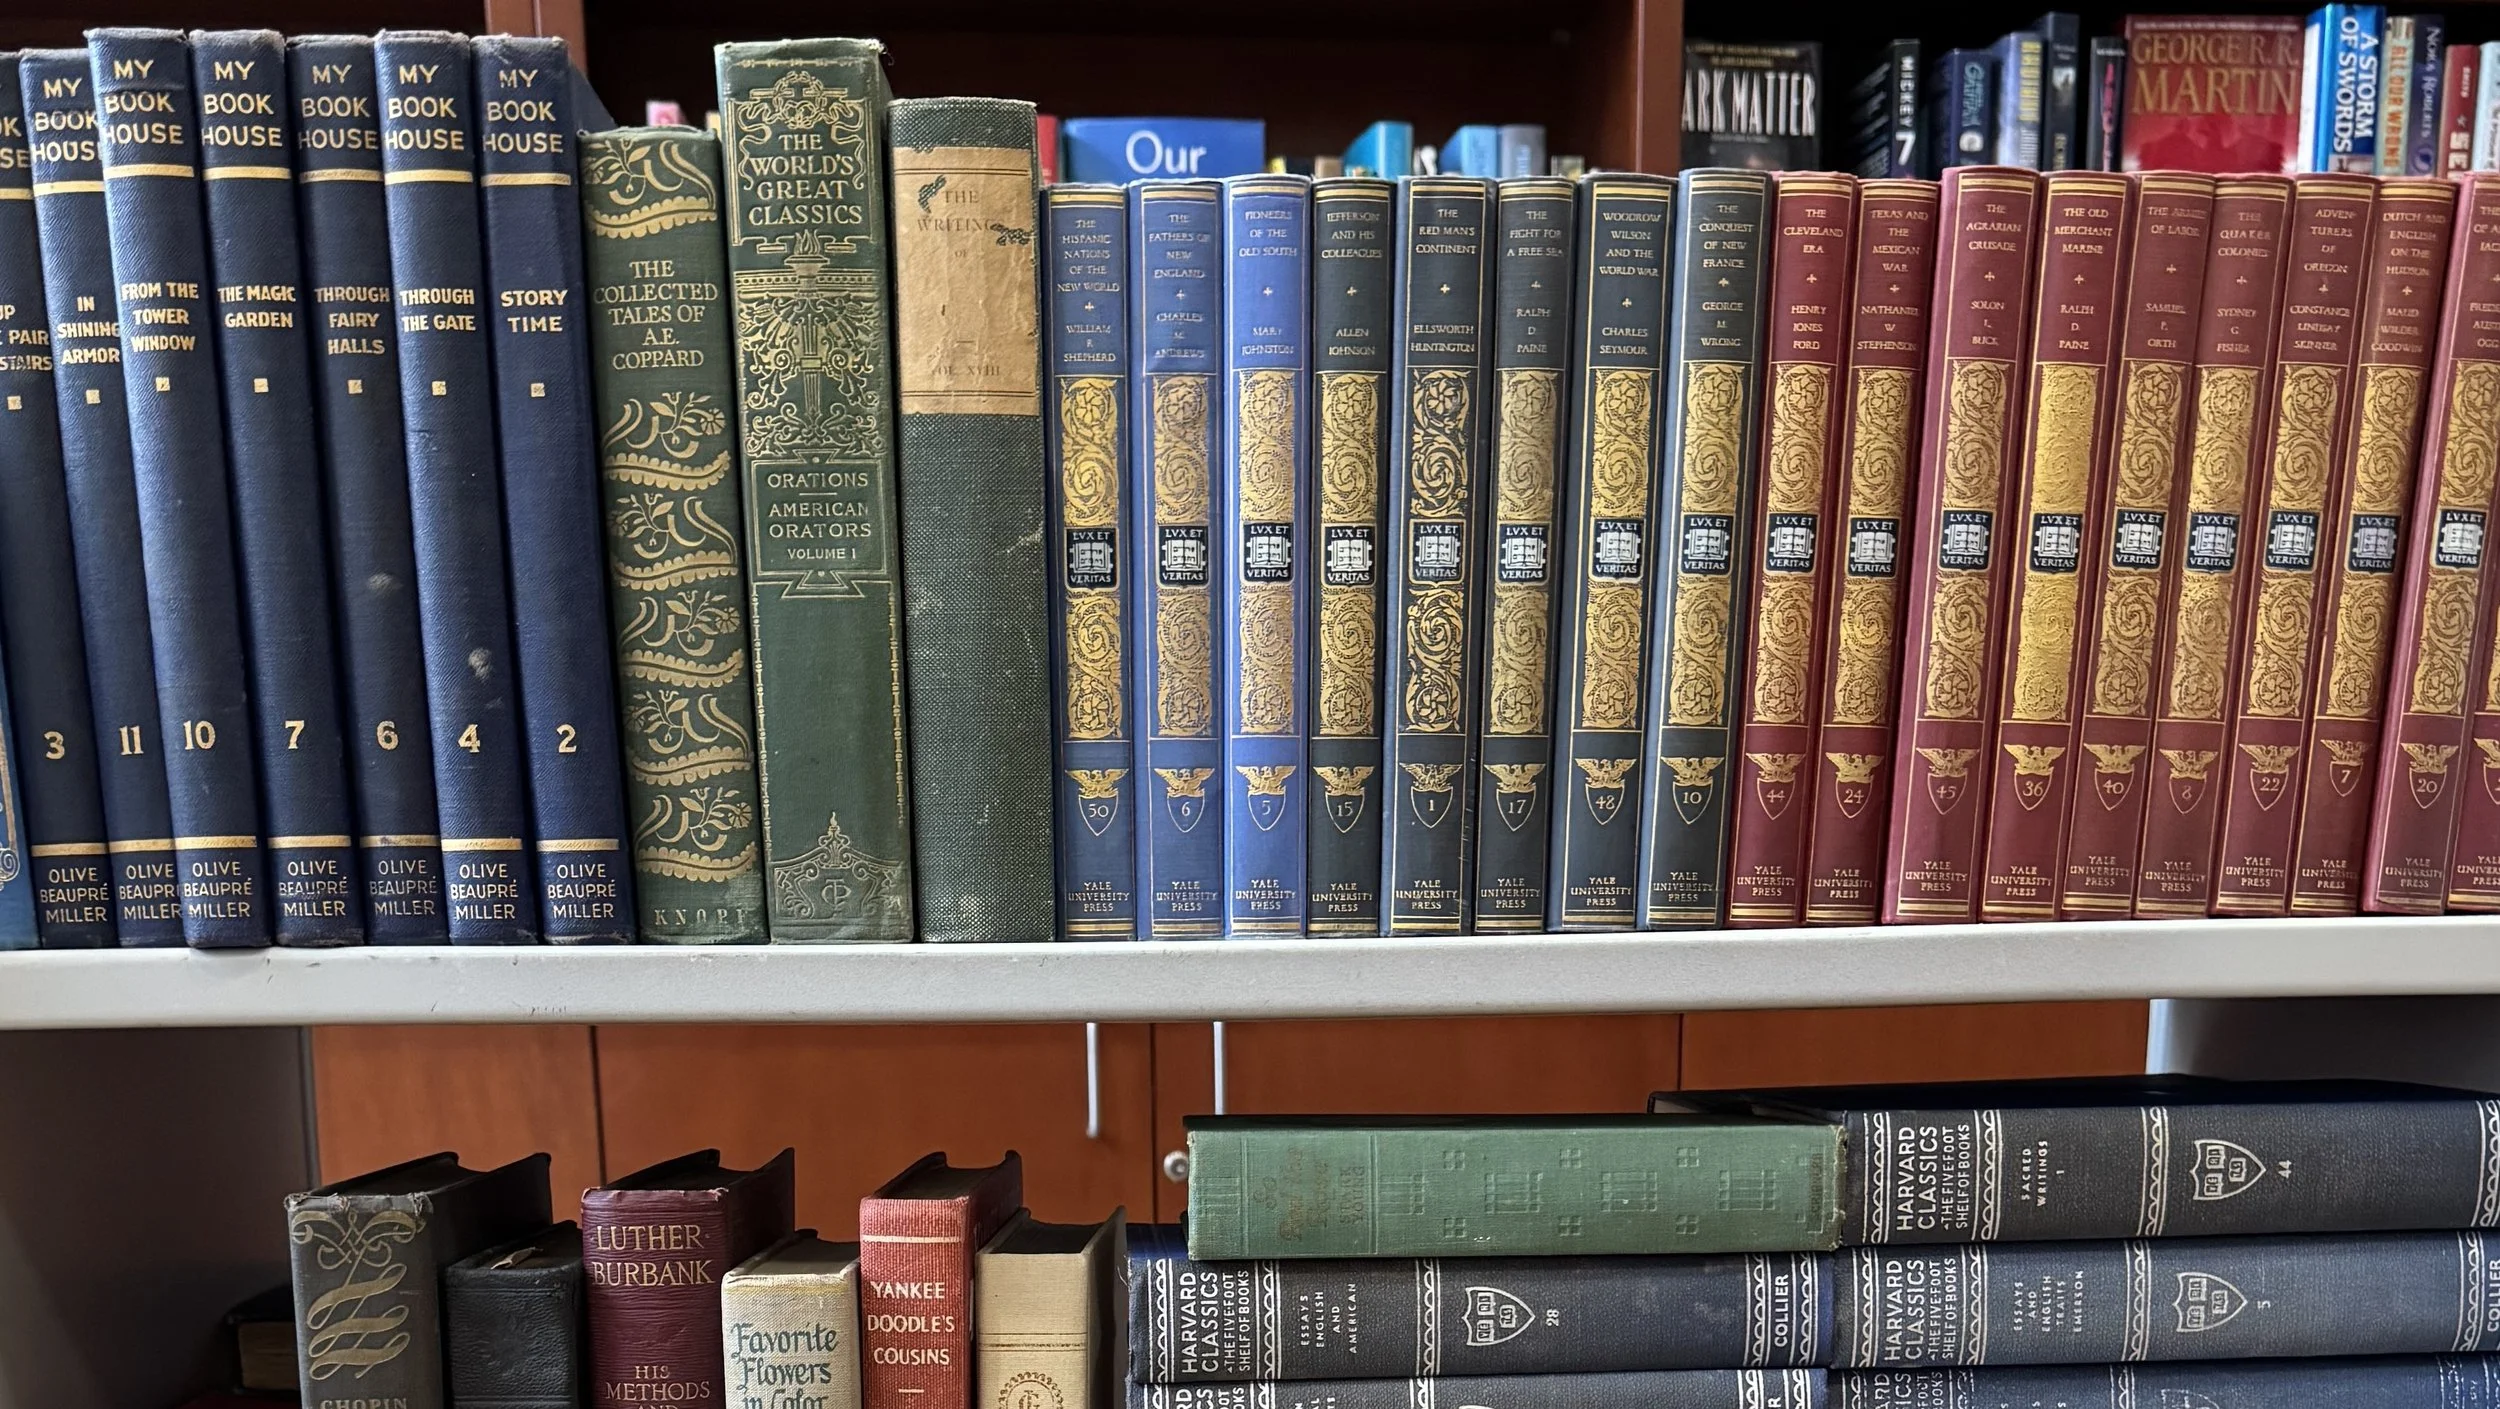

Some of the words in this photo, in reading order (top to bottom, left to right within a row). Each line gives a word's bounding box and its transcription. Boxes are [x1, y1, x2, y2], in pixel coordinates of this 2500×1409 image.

[2340, 18, 2359, 48] OF
[2357, 32, 2378, 51] A
[2134, 34, 2244, 64] GEORGE
[2247, 35, 2276, 67] R.
[2277, 38, 2299, 67] R.
[114, 60, 153, 80] MY
[313, 65, 351, 84] MY
[500, 69, 537, 88] MY
[1900, 57, 1914, 126] MICKEY
[2135, 68, 2296, 117] MARTIN
[2353, 54, 2380, 139] STORM
[103, 92, 173, 114] BOOK
[302, 97, 369, 116] BOOK
[487, 100, 555, 121] BOOK
[1732, 72, 1814, 135] MATTER
[2334, 52, 2357, 151] SWORDS
[103, 123, 182, 145] HOUSE
[304, 129, 375, 148] HOUSE
[484, 132, 562, 153] HOUSE
[779, 135, 822, 150] THE
[1126, 131, 1205, 173] Our
[1896, 132, 1915, 164] 7
[748, 153, 855, 176] WORLD'S
[757, 181, 848, 200] GREAT
[942, 191, 979, 204] THE
[749, 205, 862, 225] CLASSICS
[1437, 208, 1458, 218] THE
[1602, 212, 1662, 222] WOODROW
[1804, 208, 1826, 218] THE
[2063, 207, 2086, 217] THE
[2087, 208, 2109, 218] OLD
[1610, 230, 1651, 240] WILSON
[1783, 226, 1842, 237] CLEVELAND
[2054, 225, 2113, 237] MERCHANT
[954, 249, 968, 259] OF
[1415, 243, 1476, 255] CONTINENT
[1605, 248, 1631, 258] AND
[1633, 248, 1654, 259] THE
[1802, 244, 1824, 254] ERA
[2062, 243, 2103, 254] MARINE
[629, 260, 674, 278] THE
[1599, 265, 1636, 275] WORLD
[1636, 266, 1659, 277] WAR
[121, 281, 161, 301] FROM
[166, 282, 198, 298] THE
[218, 286, 243, 302] THE
[247, 286, 295, 301] MAGIC
[315, 287, 389, 302] THROUGH
[400, 289, 474, 307] THROUGH
[501, 290, 567, 306] STORY
[594, 284, 718, 303] COLLECTED
[77, 297, 94, 311] IN
[132, 308, 188, 326] TOWER
[225, 312, 292, 327] GARDEN
[329, 313, 379, 328] FAIRY
[401, 315, 428, 332] THE
[434, 315, 475, 330] GATE
[508, 316, 562, 332] TIME
[609, 306, 671, 325] TALES
[677, 305, 705, 322] OF
[9, 330, 48, 344] PAIR
[56, 321, 121, 339] SHINING
[1413, 324, 1474, 334] ELLSWORTH
[1601, 326, 1648, 337] CHARLES
[130, 333, 194, 353] WINDOW
[328, 339, 384, 355] HALLS
[1410, 342, 1475, 353] HUNTINGTON
[1599, 344, 1648, 355] SEYMOUR
[60, 347, 119, 366] ARMOR
[613, 350, 703, 369] COPPARD
[768, 473, 868, 488] ORATIONS
[769, 503, 868, 517] AMERICAN
[770, 523, 871, 538] ORATORS
[1355, 528, 1369, 538] ET
[787, 547, 847, 560] VOLUME
[1327, 572, 1370, 583] VERITAS
[120, 726, 143, 755] 11
[183, 721, 215, 750] 10
[285, 720, 304, 749] 7
[377, 721, 398, 750] 6
[458, 724, 480, 752] 4
[557, 724, 576, 752] 2
[45, 732, 64, 759] 3
[2023, 781, 2045, 797] 36
[2103, 780, 2125, 796] 40
[2260, 777, 2279, 791] 22
[1596, 795, 1616, 811] 48
[1682, 791, 1702, 804] 10
[1767, 790, 1784, 803] 44
[1844, 789, 1863, 803] 24
[1089, 804, 1108, 817] 50
[1181, 801, 1191, 817] 6
[1262, 799, 1271, 816] 5
[1338, 802, 1353, 816] 15
[1509, 800, 1526, 813] 17
[49, 868, 96, 883] OLIVE
[557, 864, 605, 878] OLIVE
[1588, 876, 1616, 885] YALE
[41, 880, 108, 902] BEAUPRÉ
[547, 877, 615, 899] BEAUPRÉ
[1570, 886, 1631, 896] UNIVERSITY
[1586, 897, 1617, 906] PRESS
[47, 907, 106, 922] MILLER
[552, 902, 613, 921] MILLER
[655, 907, 752, 926] KNOPF
[1897, 1127, 1915, 1230] HARVARD
[1918, 1127, 1937, 1229] CLASSICS
[2021, 1148, 2032, 1200] SACRED
[2037, 1140, 2048, 1207] WRITINGS
[2279, 1160, 2291, 1178] 44
[595, 1224, 707, 1252] LUTHER
[591, 1258, 712, 1286] BURBANK
[871, 1281, 945, 1301] YANKEE
[1237, 1270, 1250, 1314] BOOKS
[1774, 1274, 1789, 1348] COLLIER
[1885, 1261, 1903, 1360] HARVARD
[1906, 1260, 1925, 1359] CLASSICS
[2013, 1281, 2024, 1331] ESSAYS
[2027, 1291, 2037, 1319] AND
[2041, 1275, 2052, 1332] ENGLISH
[2055, 1280, 2067, 1326] TRAITS
[2073, 1270, 2084, 1333] EMERSON
[868, 1313, 954, 1334] DOODLE'S
[1180, 1273, 1197, 1372] HARVARD
[1200, 1273, 1218, 1371] CLASSICS
[1238, 1316, 1251, 1333] OF
[1299, 1295, 1310, 1346] ESSAYS
[1314, 1291, 1325, 1348] ENGLISH
[1331, 1305, 1341, 1333] AND
[1347, 1283, 1358, 1354] AMERICAN
[1546, 1309, 1559, 1326] 28
[731, 1322, 839, 1360] Favorite
[874, 1348, 951, 1367] COUSINS
[1238, 1333, 1251, 1372] SHELF
[635, 1366, 669, 1379] HIS
[739, 1357, 832, 1392] Flowers
[607, 1382, 709, 1401] METHODS
[742, 1389, 764, 1409] in
